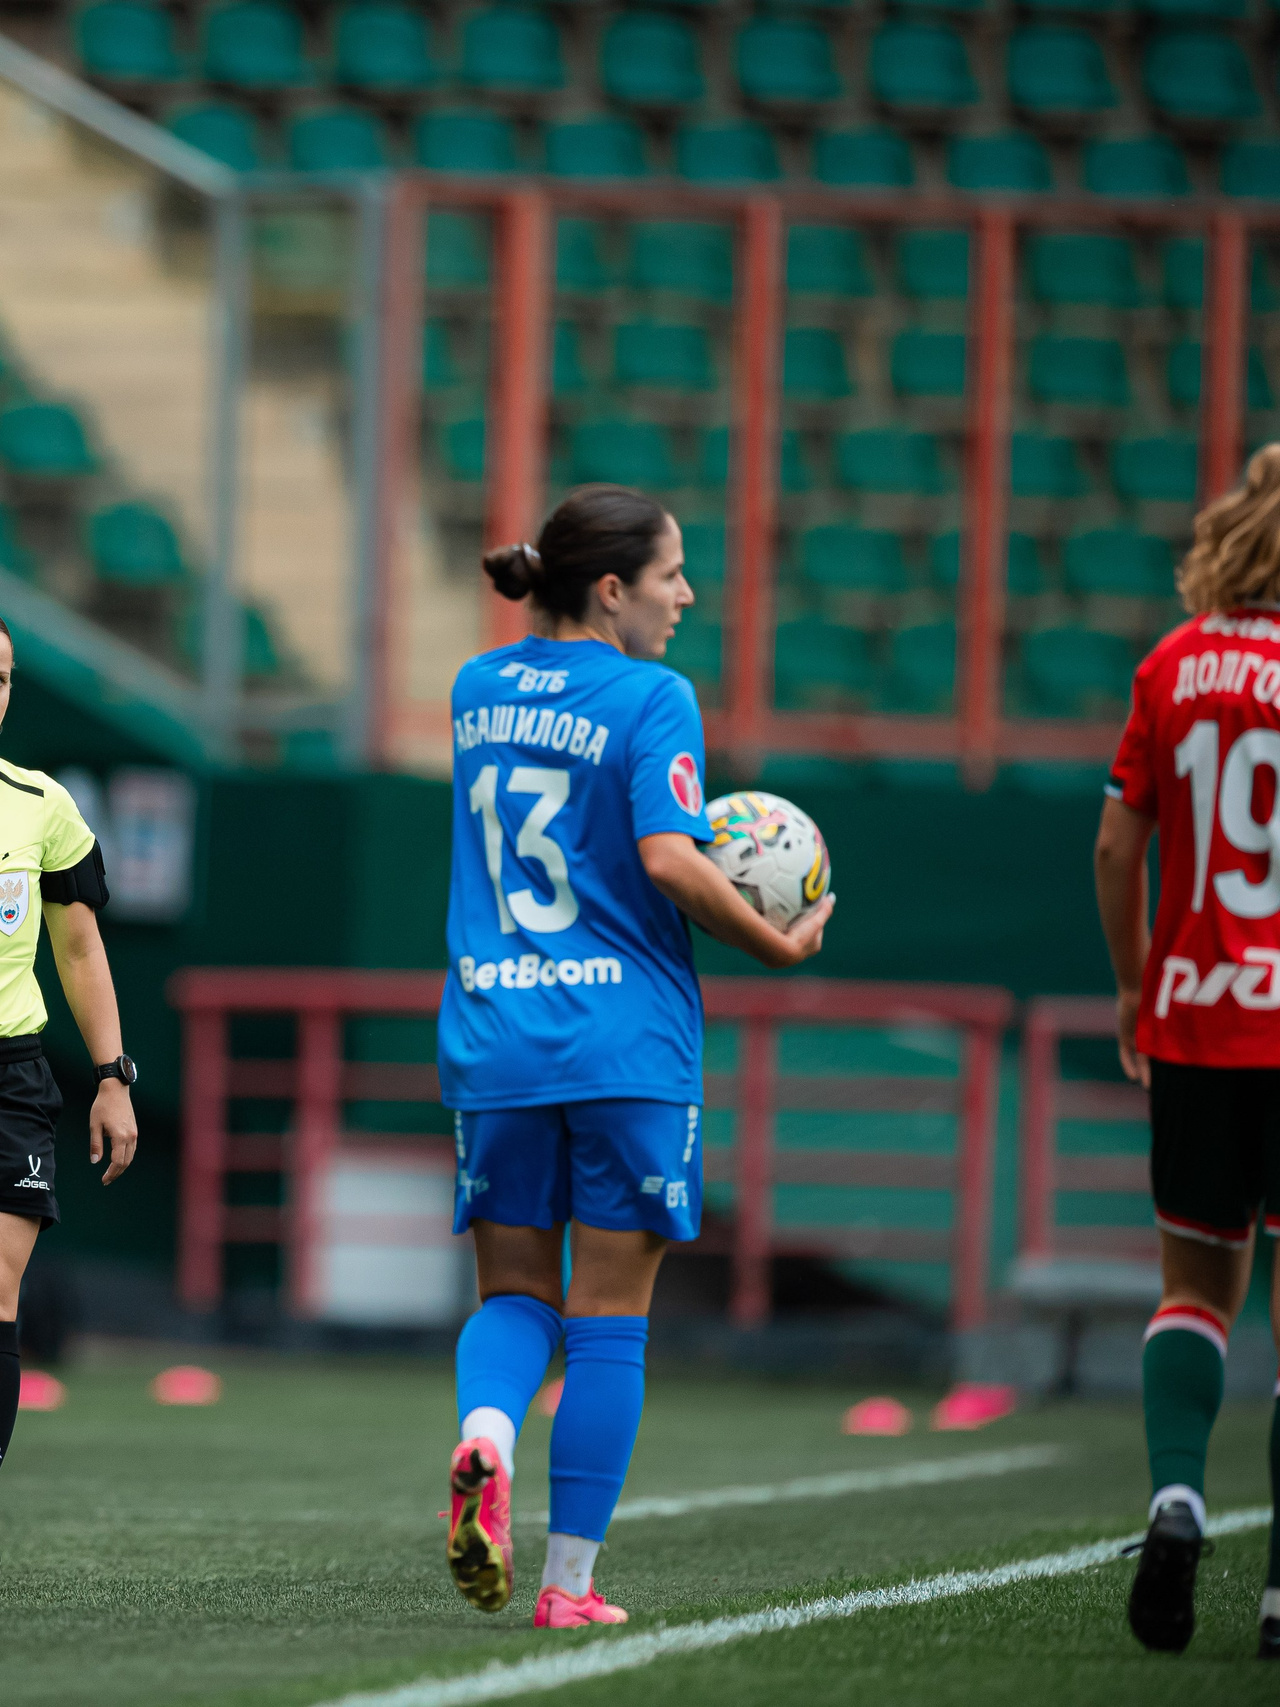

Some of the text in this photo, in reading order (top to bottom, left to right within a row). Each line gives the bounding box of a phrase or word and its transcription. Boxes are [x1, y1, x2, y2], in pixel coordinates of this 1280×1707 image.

[1172, 649, 1280, 710] ДОЛГО
[455, 704, 610, 766] АБАШИЛОВА
[470, 764, 580, 935] 13
[1174, 719, 1280, 919] 19
[459, 953, 622, 993] BetBoom
[13, 1177, 51, 1191] JÖGEL
